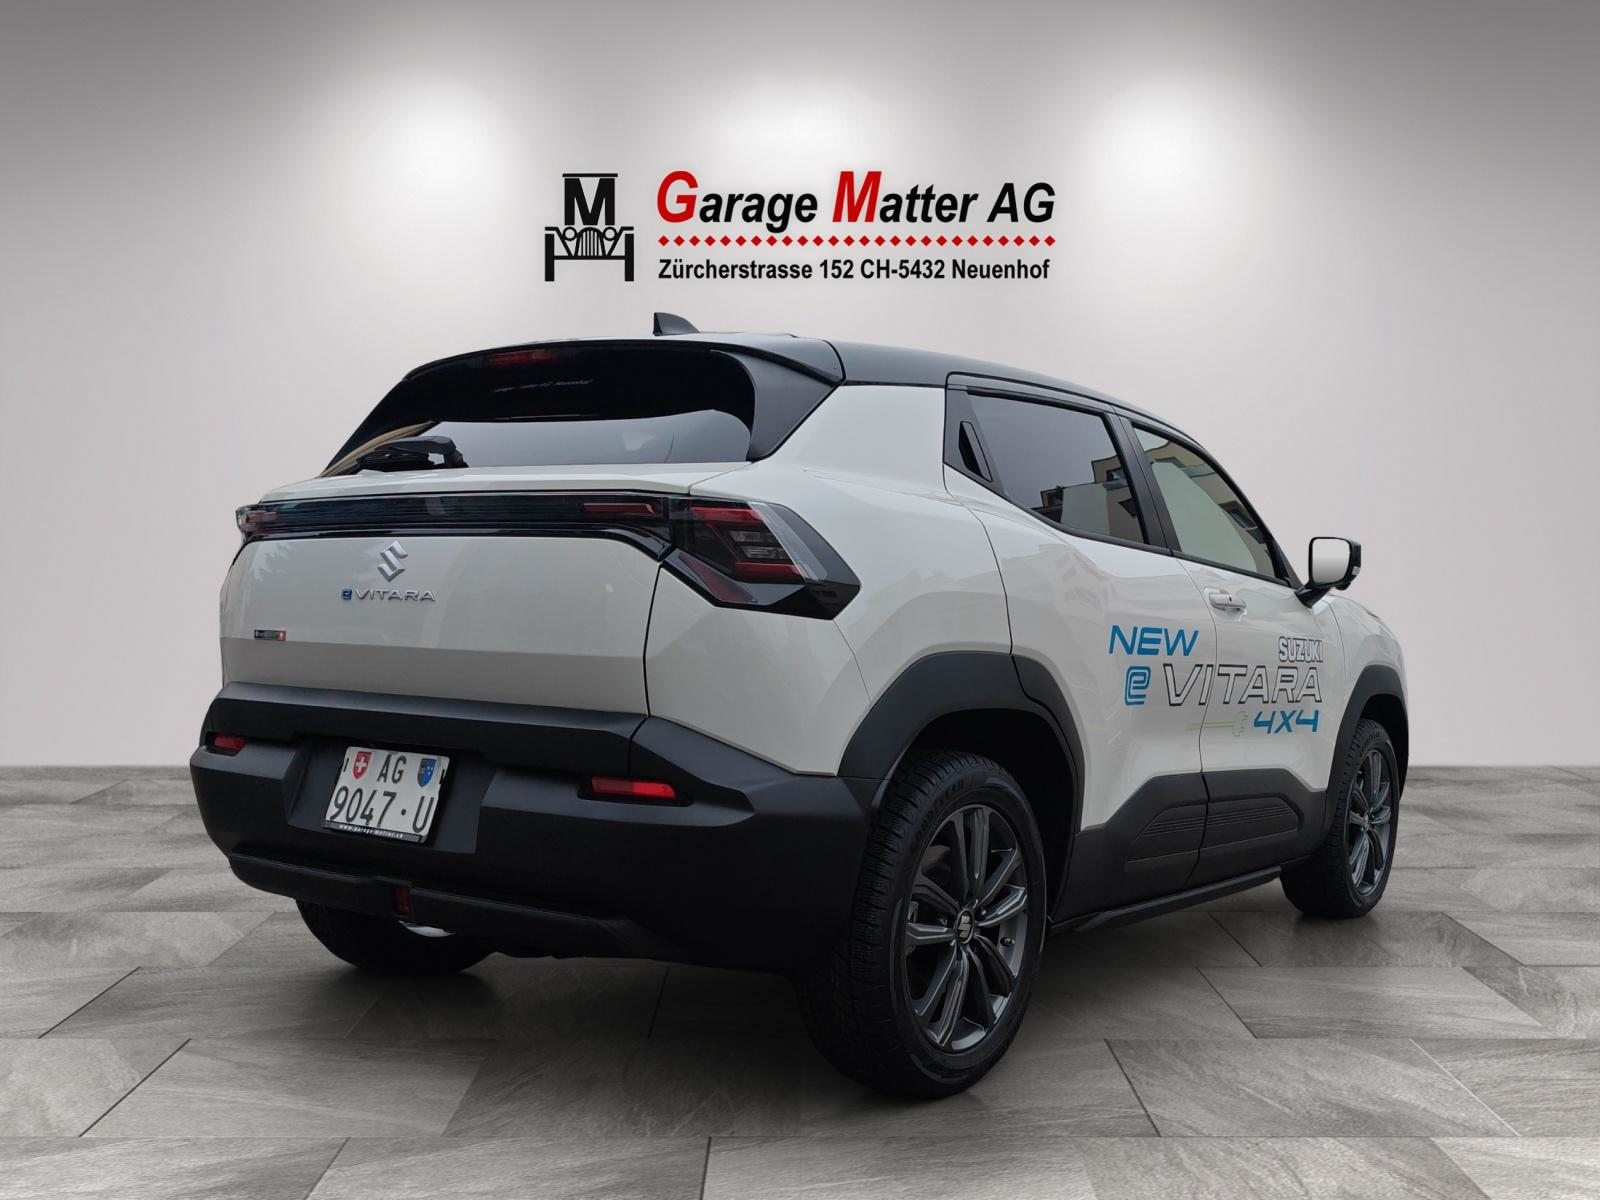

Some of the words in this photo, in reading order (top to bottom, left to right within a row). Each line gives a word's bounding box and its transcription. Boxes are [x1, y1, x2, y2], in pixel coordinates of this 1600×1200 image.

[656, 170, 818, 234] Garage
[832, 170, 979, 223] Matter
[986, 182, 1056, 223] AG
[658, 258, 813, 279] Zürcherstrasse
[819, 259, 854, 279] 152
[860, 258, 945, 279] CH-5432
[952, 258, 1051, 279] Neuenhof
[1108, 624, 1200, 657] NEW
[1277, 635, 1324, 663] SUZUKI
[1162, 663, 1323, 707] VITARA
[377, 754, 407, 784] AG
